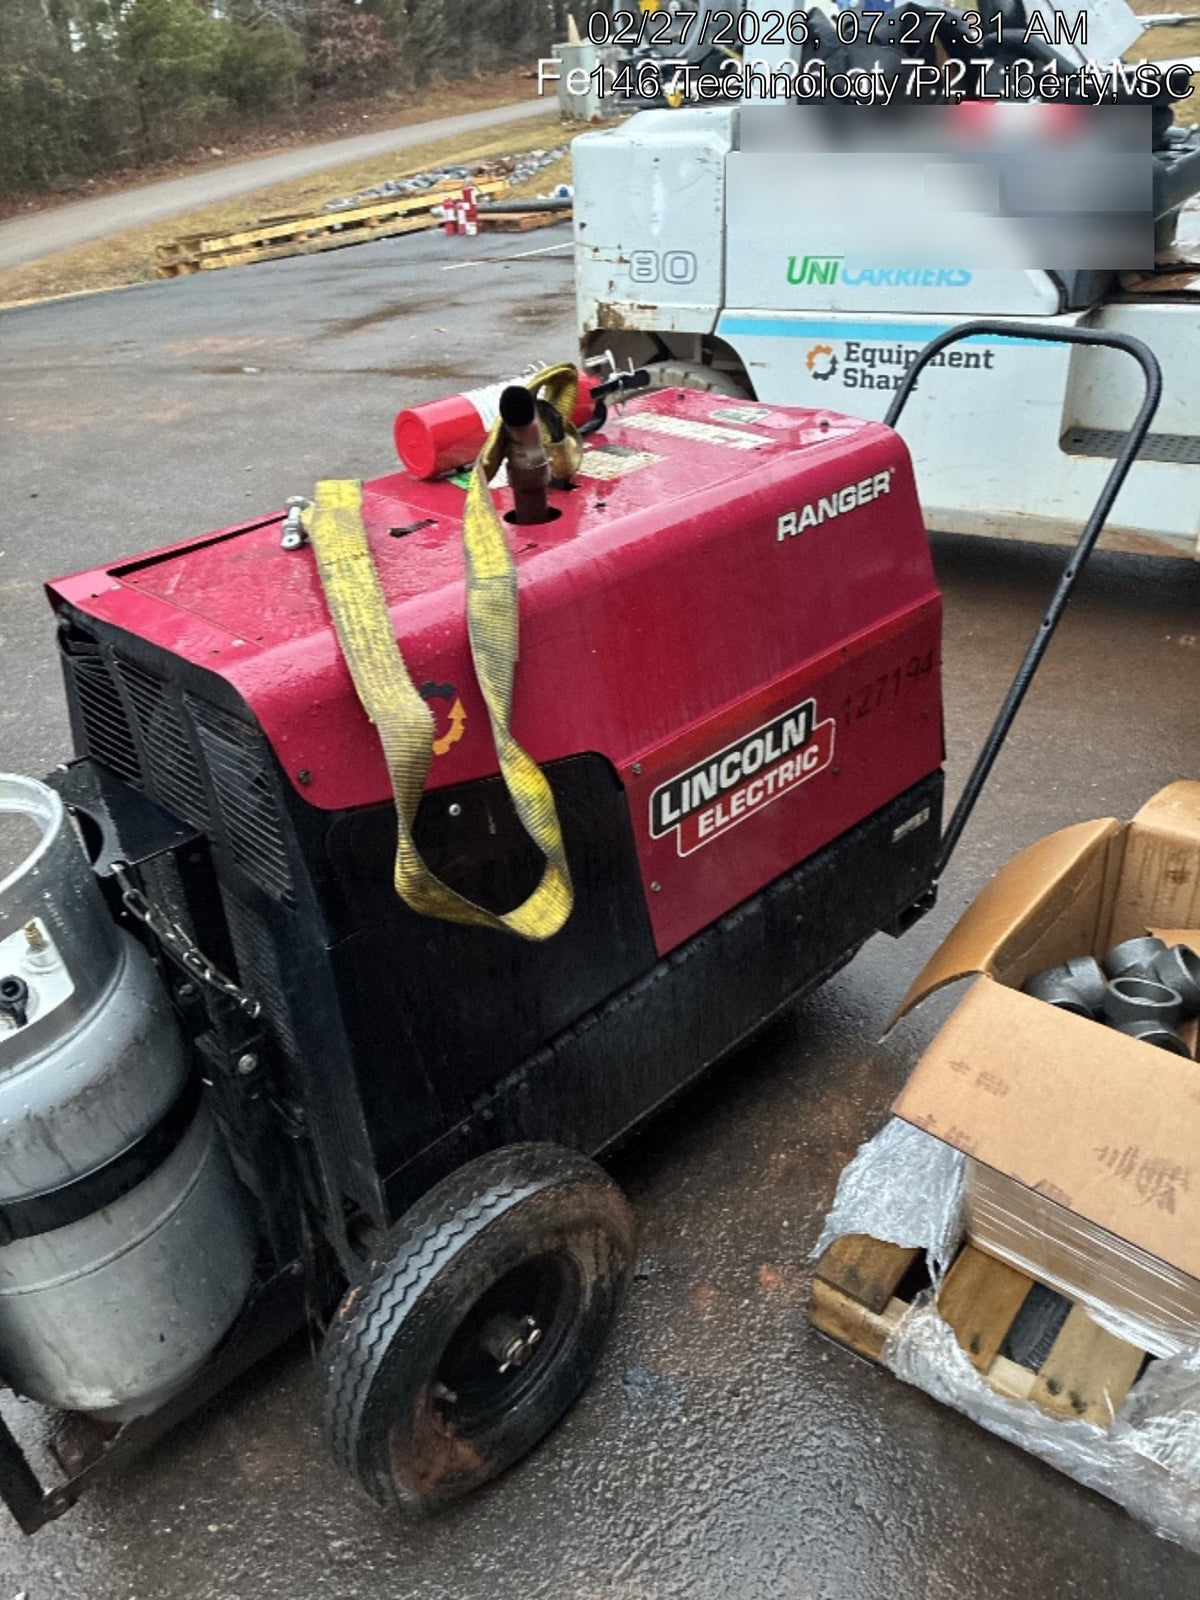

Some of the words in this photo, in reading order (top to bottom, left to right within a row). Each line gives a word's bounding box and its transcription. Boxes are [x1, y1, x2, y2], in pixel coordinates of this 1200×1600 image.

[629, 250, 698, 285] 80
[660, 711, 807, 827] LINCOLN
[697, 745, 820, 838] ELECTRIC
